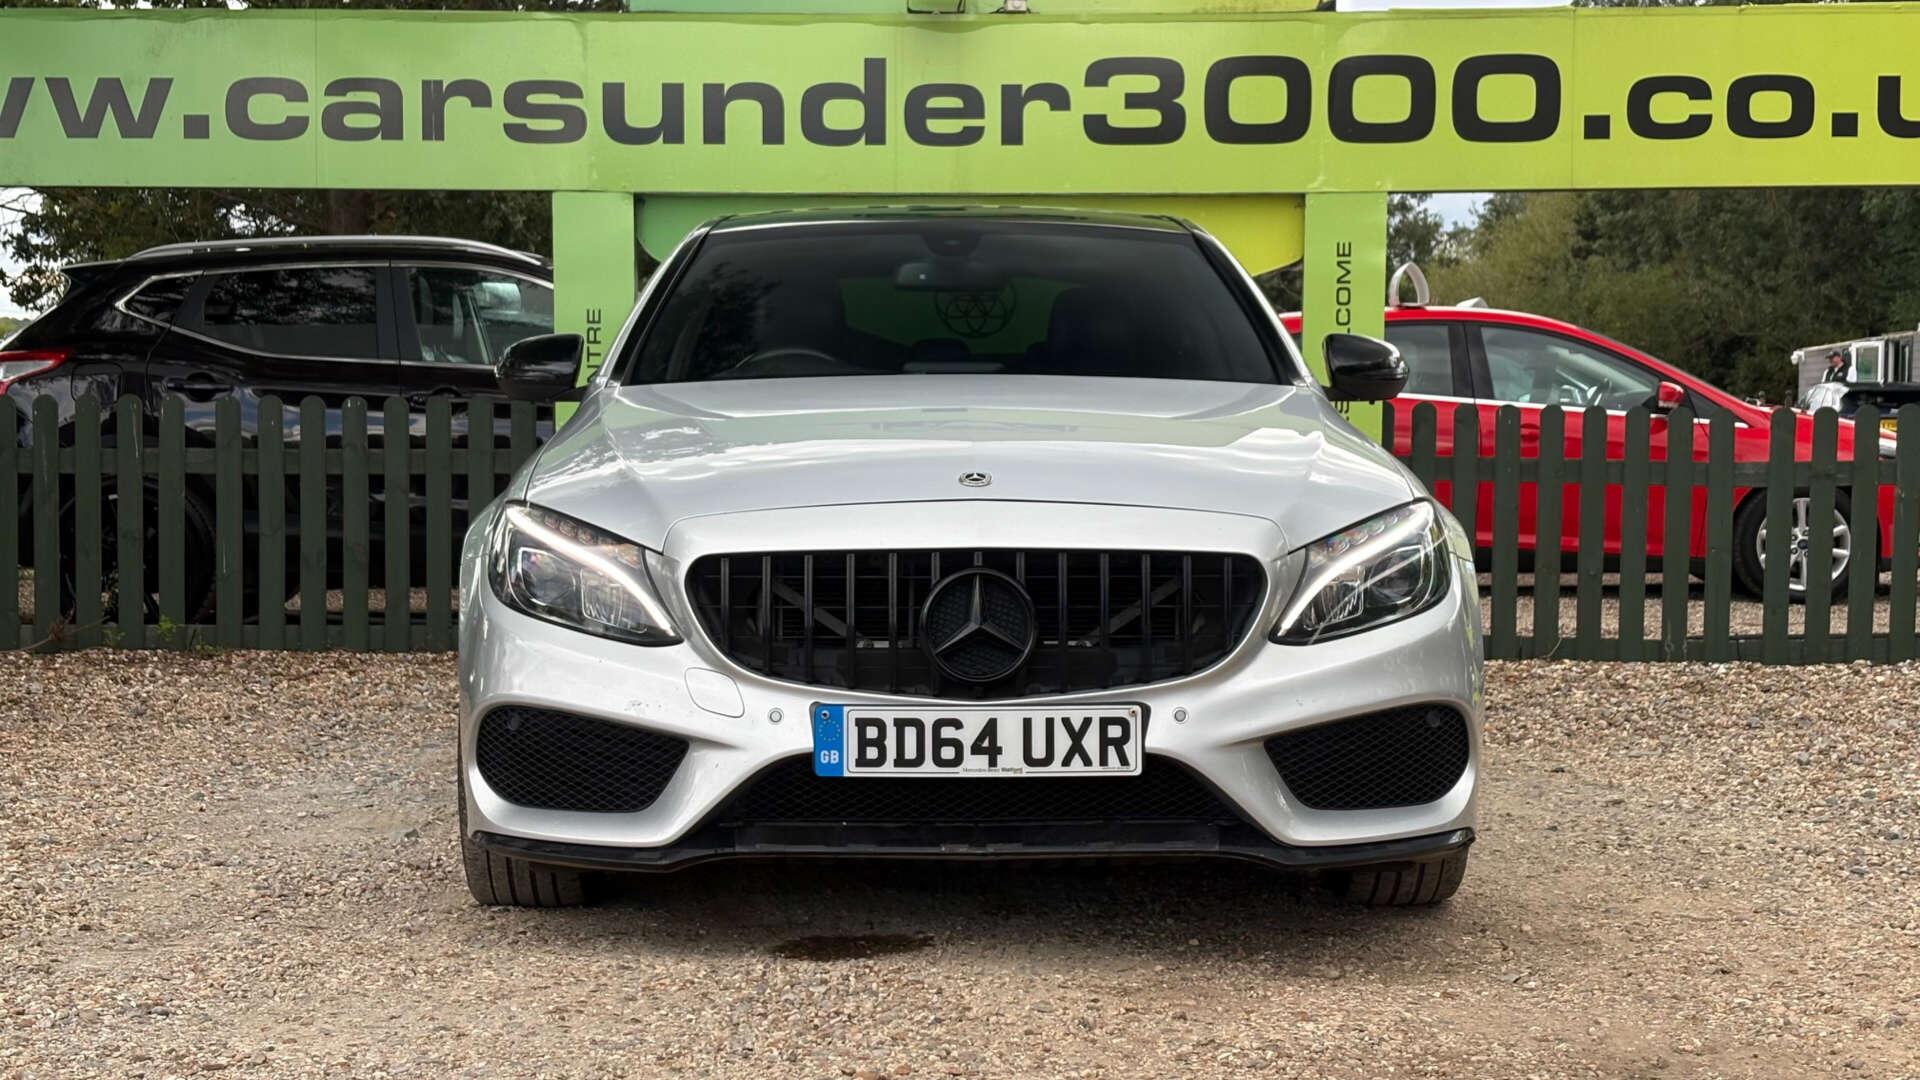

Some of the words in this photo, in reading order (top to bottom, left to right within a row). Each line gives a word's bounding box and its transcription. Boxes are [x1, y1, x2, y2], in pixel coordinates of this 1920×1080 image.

[1336, 242, 1352, 333] COME
[586, 308, 602, 383] NTRE
[820, 750, 840, 764] GB
[854, 717, 1003, 768] BD64
[1022, 717, 1131, 768] UXR
